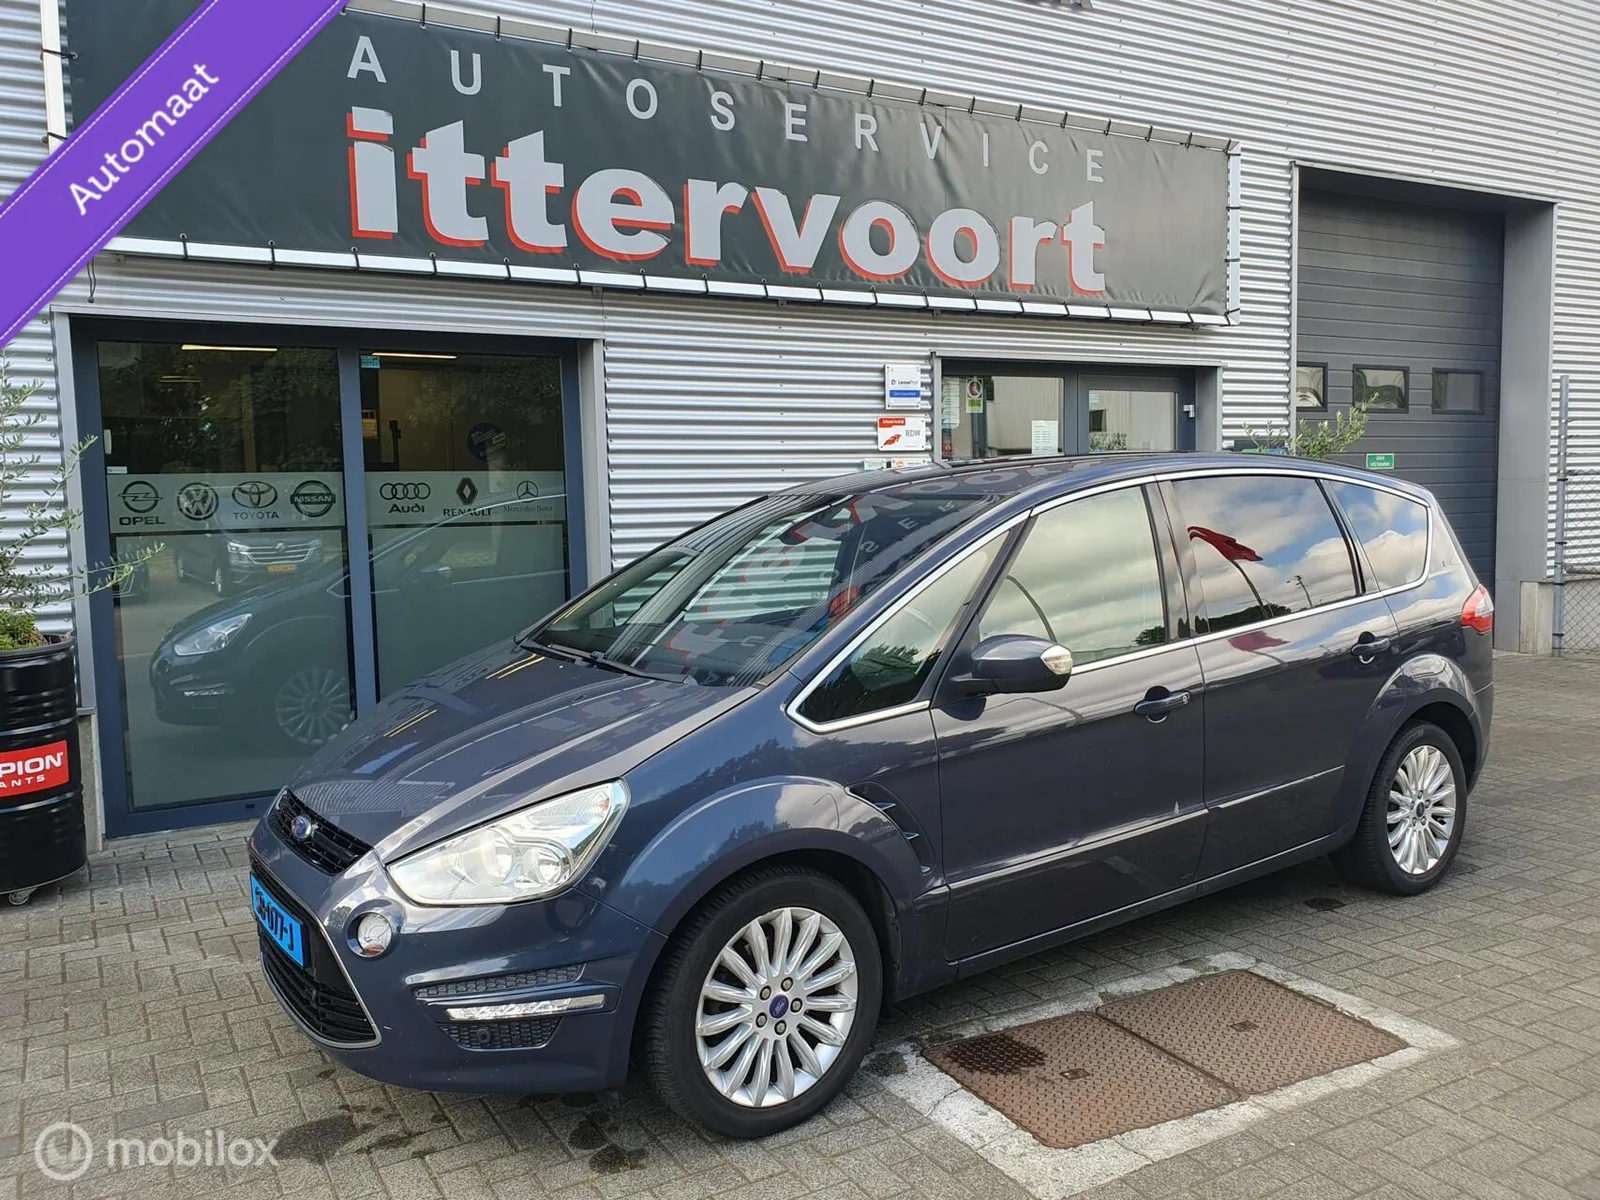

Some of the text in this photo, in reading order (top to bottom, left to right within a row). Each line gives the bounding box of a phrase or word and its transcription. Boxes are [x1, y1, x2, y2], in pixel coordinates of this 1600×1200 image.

[345, 105, 1106, 295] ittervoort
[294, 495, 333, 503] NISSAN
[388, 503, 426, 514] Audi
[443, 508, 493, 517] RENAULT
[119, 516, 165, 526] OPEL
[233, 511, 279, 521] TOYOTA
